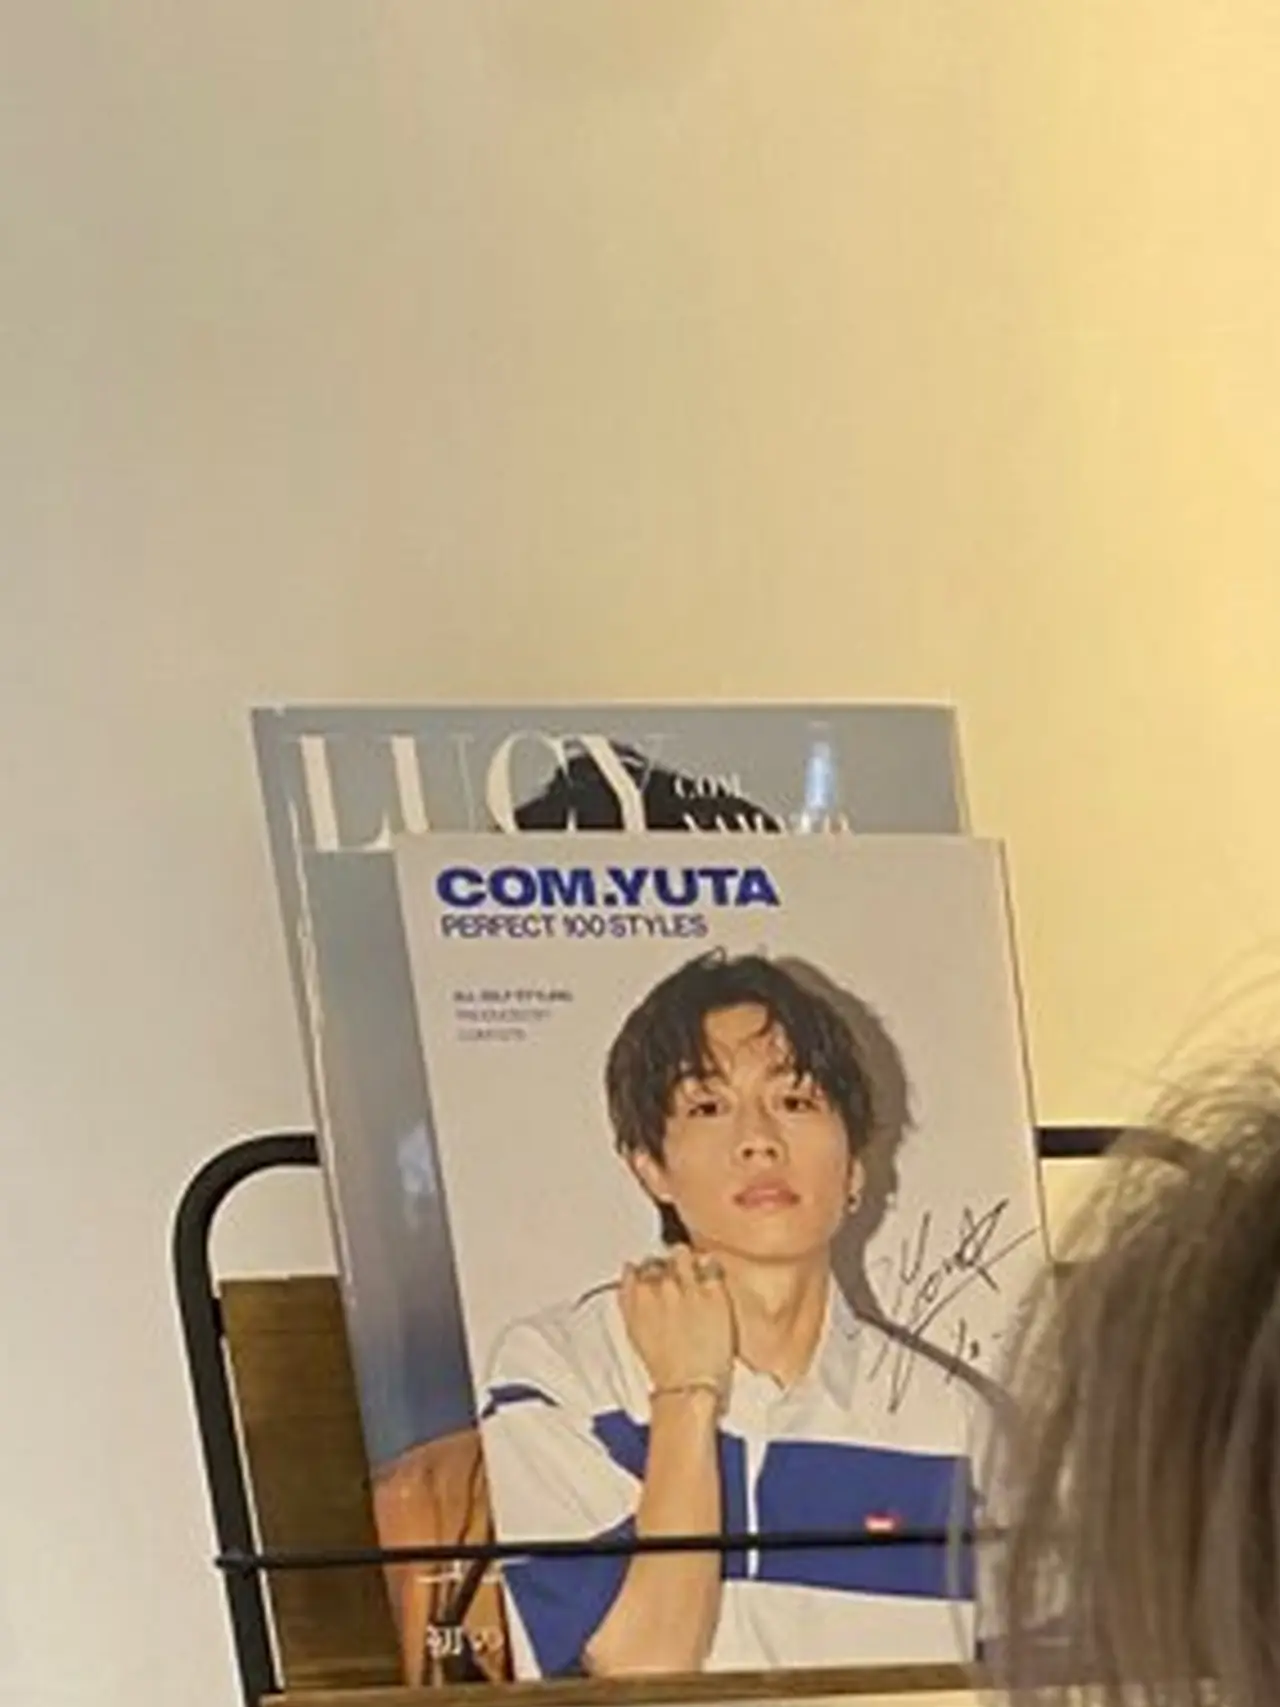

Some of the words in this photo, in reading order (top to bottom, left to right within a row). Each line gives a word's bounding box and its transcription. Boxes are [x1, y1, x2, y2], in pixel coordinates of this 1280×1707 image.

[436, 868, 781, 907] COM.YUTA
[441, 914, 556, 939] PERFECT
[562, 914, 605, 939] 100
[610, 914, 709, 939] STYLES
